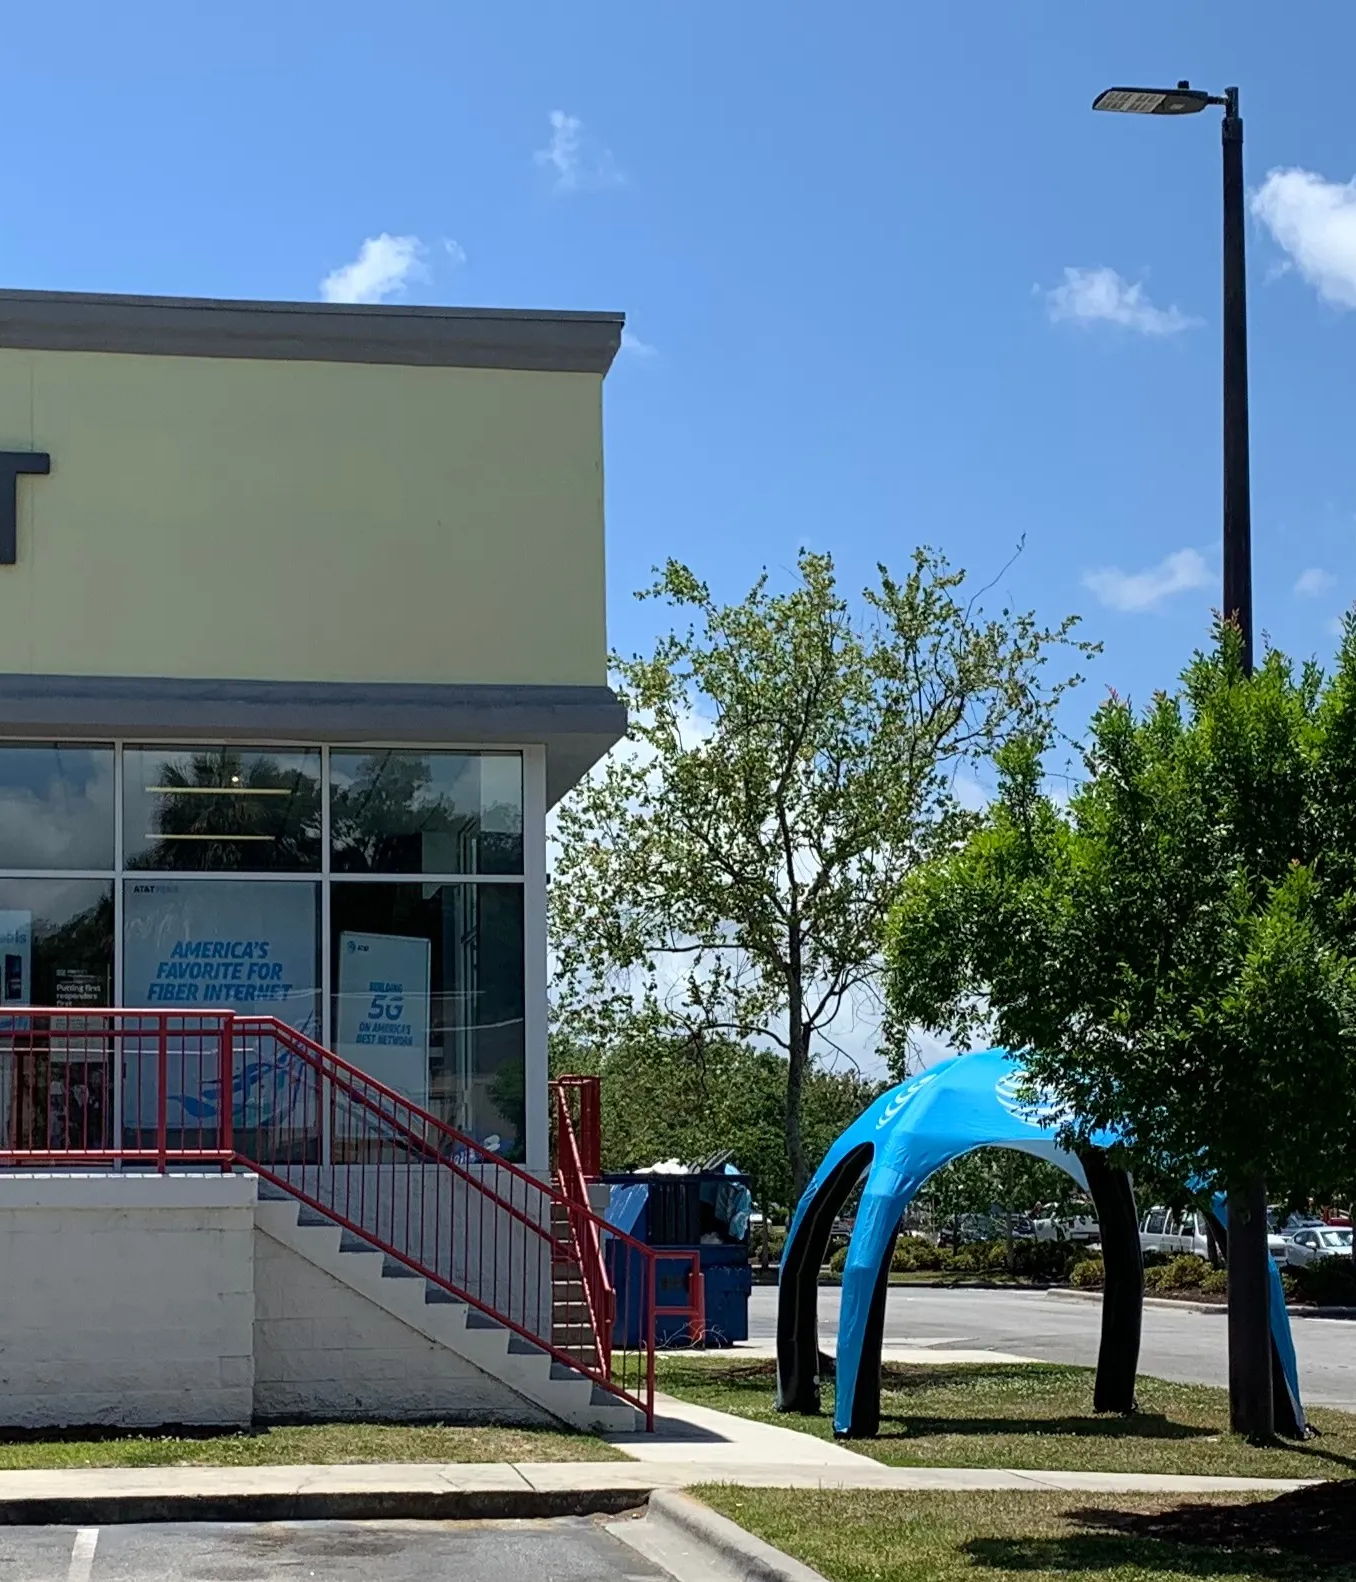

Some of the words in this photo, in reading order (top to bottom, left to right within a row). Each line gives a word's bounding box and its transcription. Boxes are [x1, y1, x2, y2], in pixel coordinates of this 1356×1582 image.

[133, 885, 155, 893] AT&T
[170, 940, 269, 959] AMERICA'S
[156, 962, 242, 980] FAVORITE
[247, 962, 283, 980] FOR
[147, 983, 200, 1000] FIBER
[203, 984, 293, 1001] INTERNET
[367, 995, 404, 1021] 5G
[359, 1022, 371, 1033] ON
[356, 1034, 376, 1044] BEST
[378, 1035, 413, 1046] NETWORK
